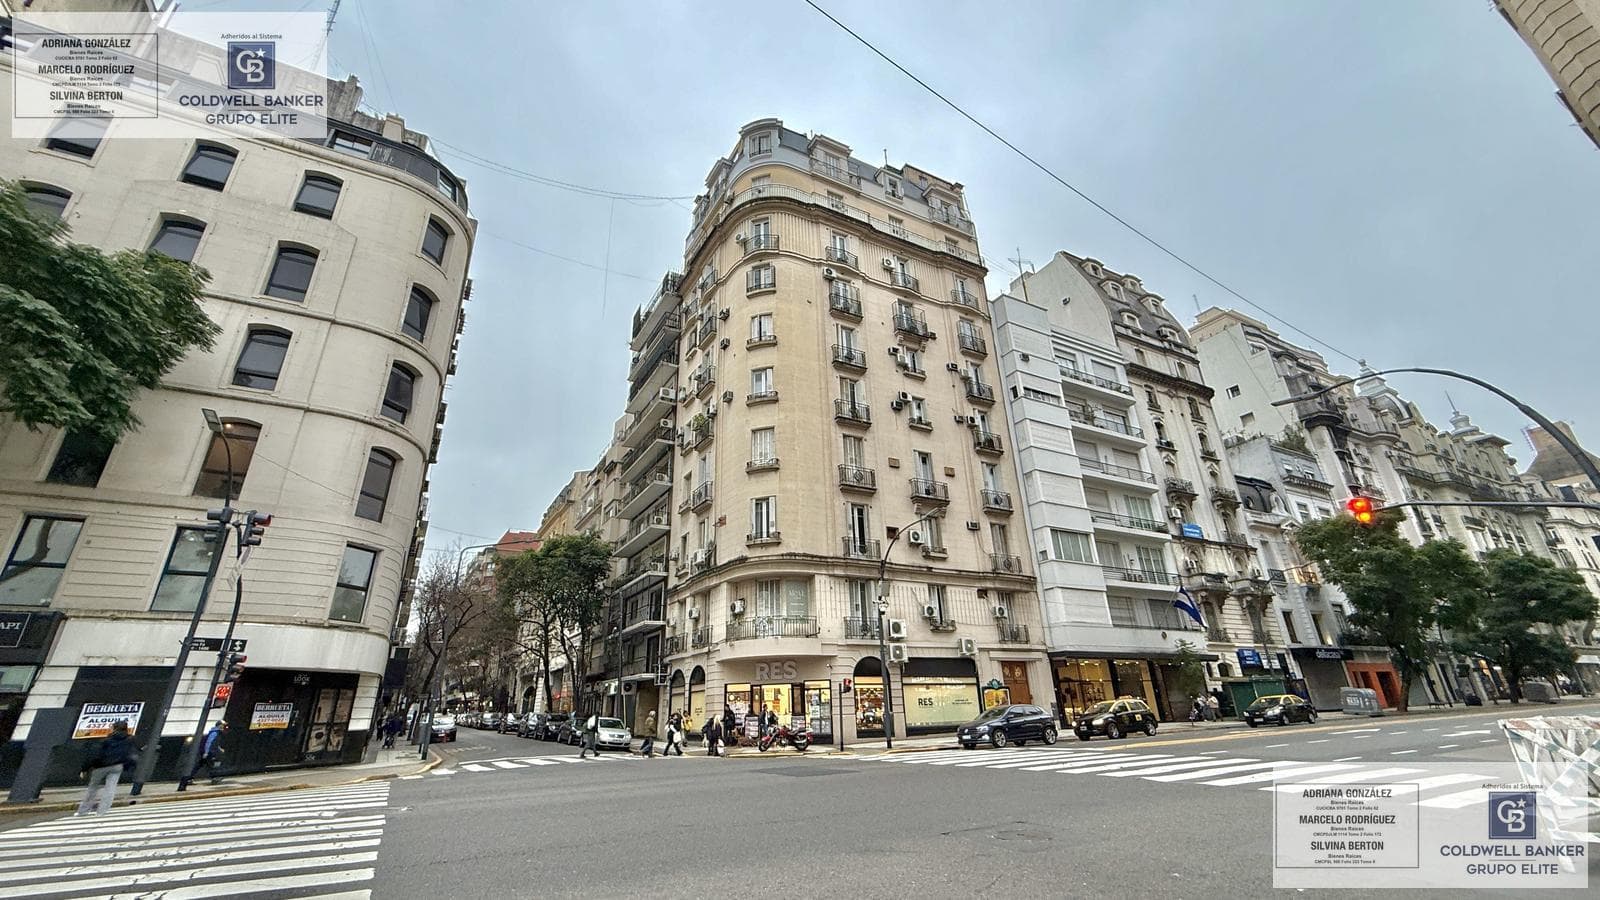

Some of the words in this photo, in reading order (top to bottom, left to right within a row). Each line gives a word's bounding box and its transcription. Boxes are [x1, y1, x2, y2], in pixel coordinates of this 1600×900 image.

[755, 660, 797, 681] RES
[917, 697, 934, 706] RES
[86, 704, 139, 713] BERRUETA
